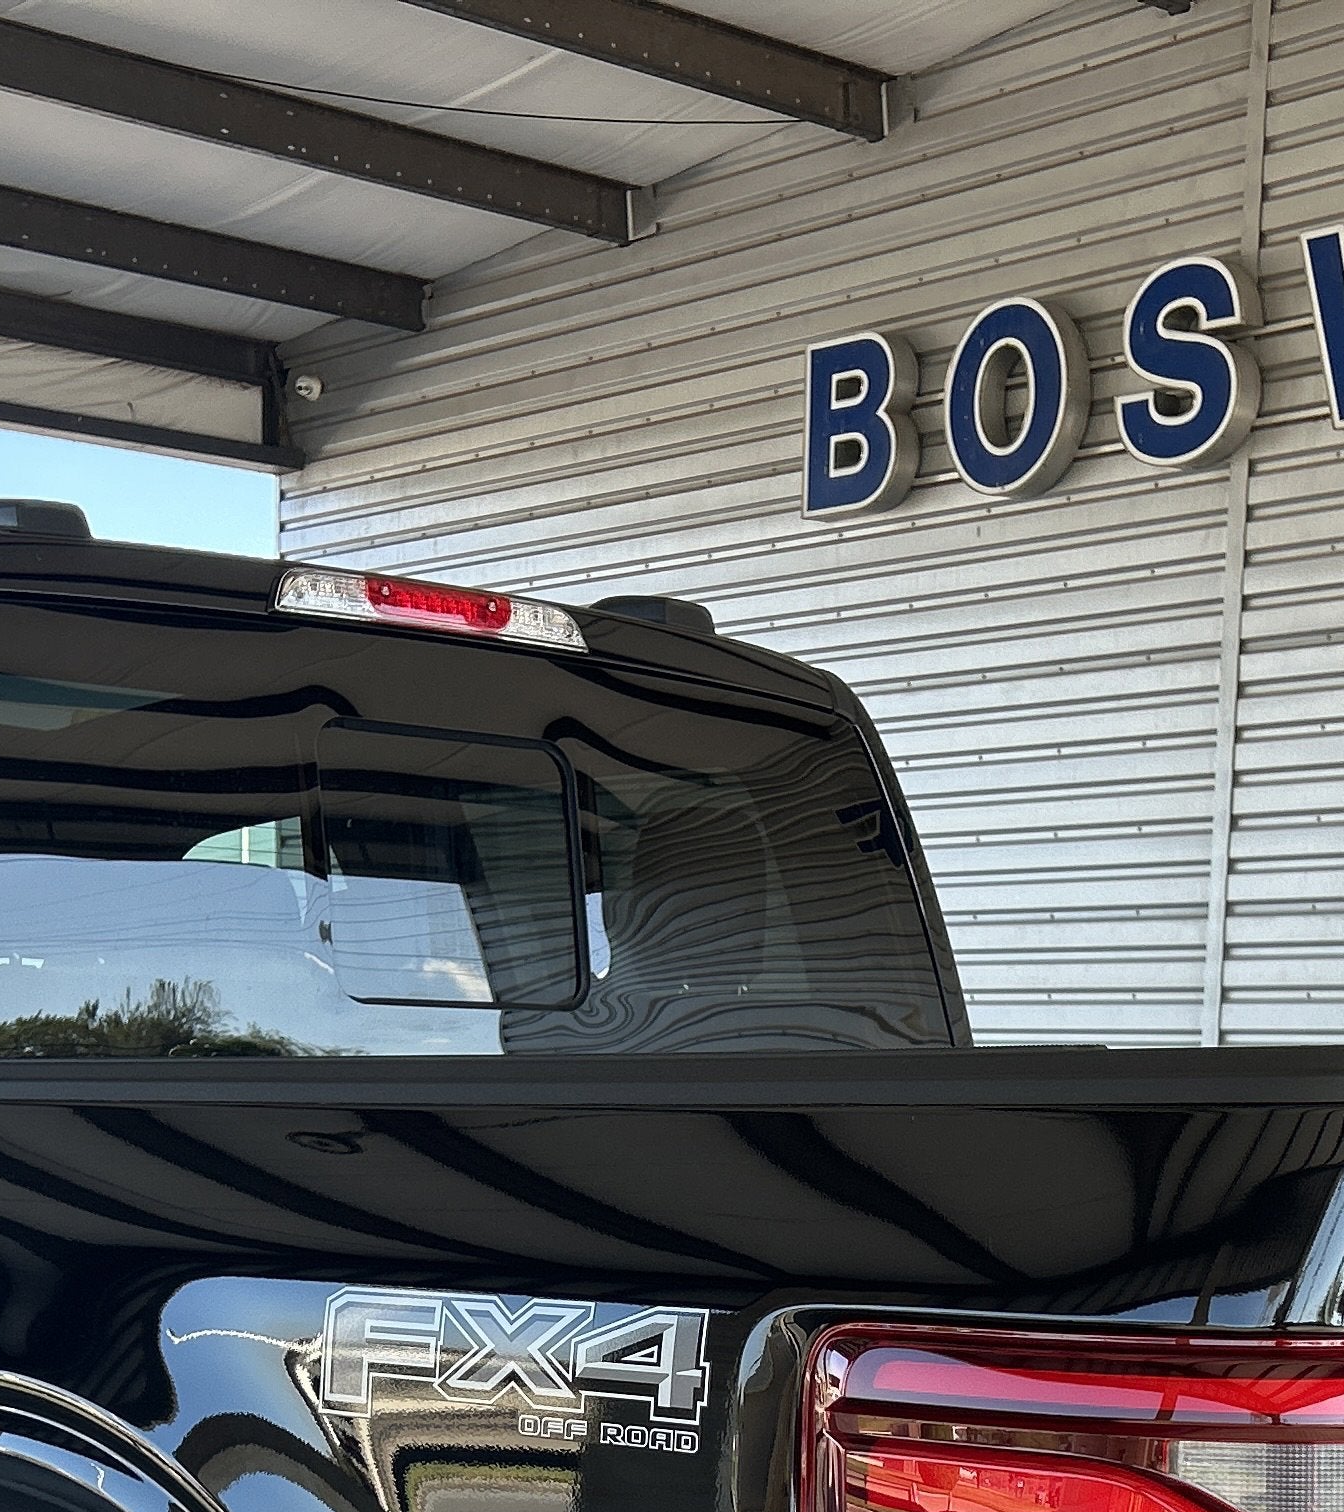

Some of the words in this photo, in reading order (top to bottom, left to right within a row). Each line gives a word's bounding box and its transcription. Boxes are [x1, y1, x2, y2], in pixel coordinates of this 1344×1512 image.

[318, 1286, 710, 1423] FX4
[518, 1415, 587, 1440] OFF
[600, 1422, 699, 1454] ROAD
